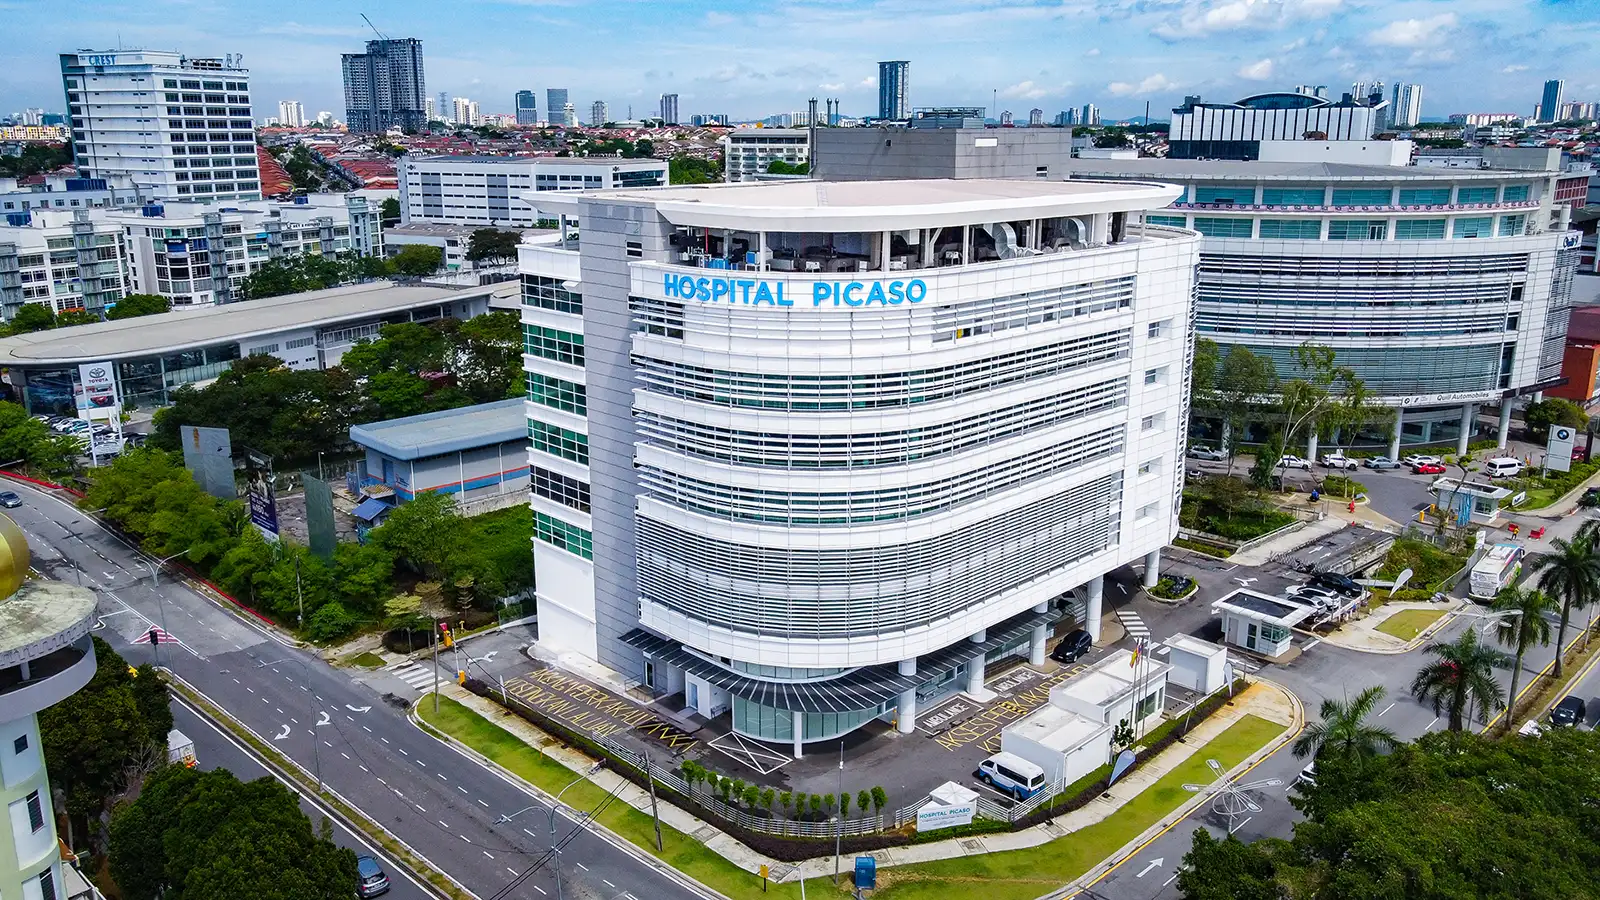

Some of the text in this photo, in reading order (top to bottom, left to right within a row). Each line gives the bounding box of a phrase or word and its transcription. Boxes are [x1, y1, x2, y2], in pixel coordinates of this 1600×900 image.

[88, 55, 116, 65] CREST
[664, 273, 927, 307] HOSPITAL PICASO
[1451, 392, 1489, 400] Automobiles
[919, 811, 947, 819] HOSPITAL
[949, 807, 971, 815] PICASO
